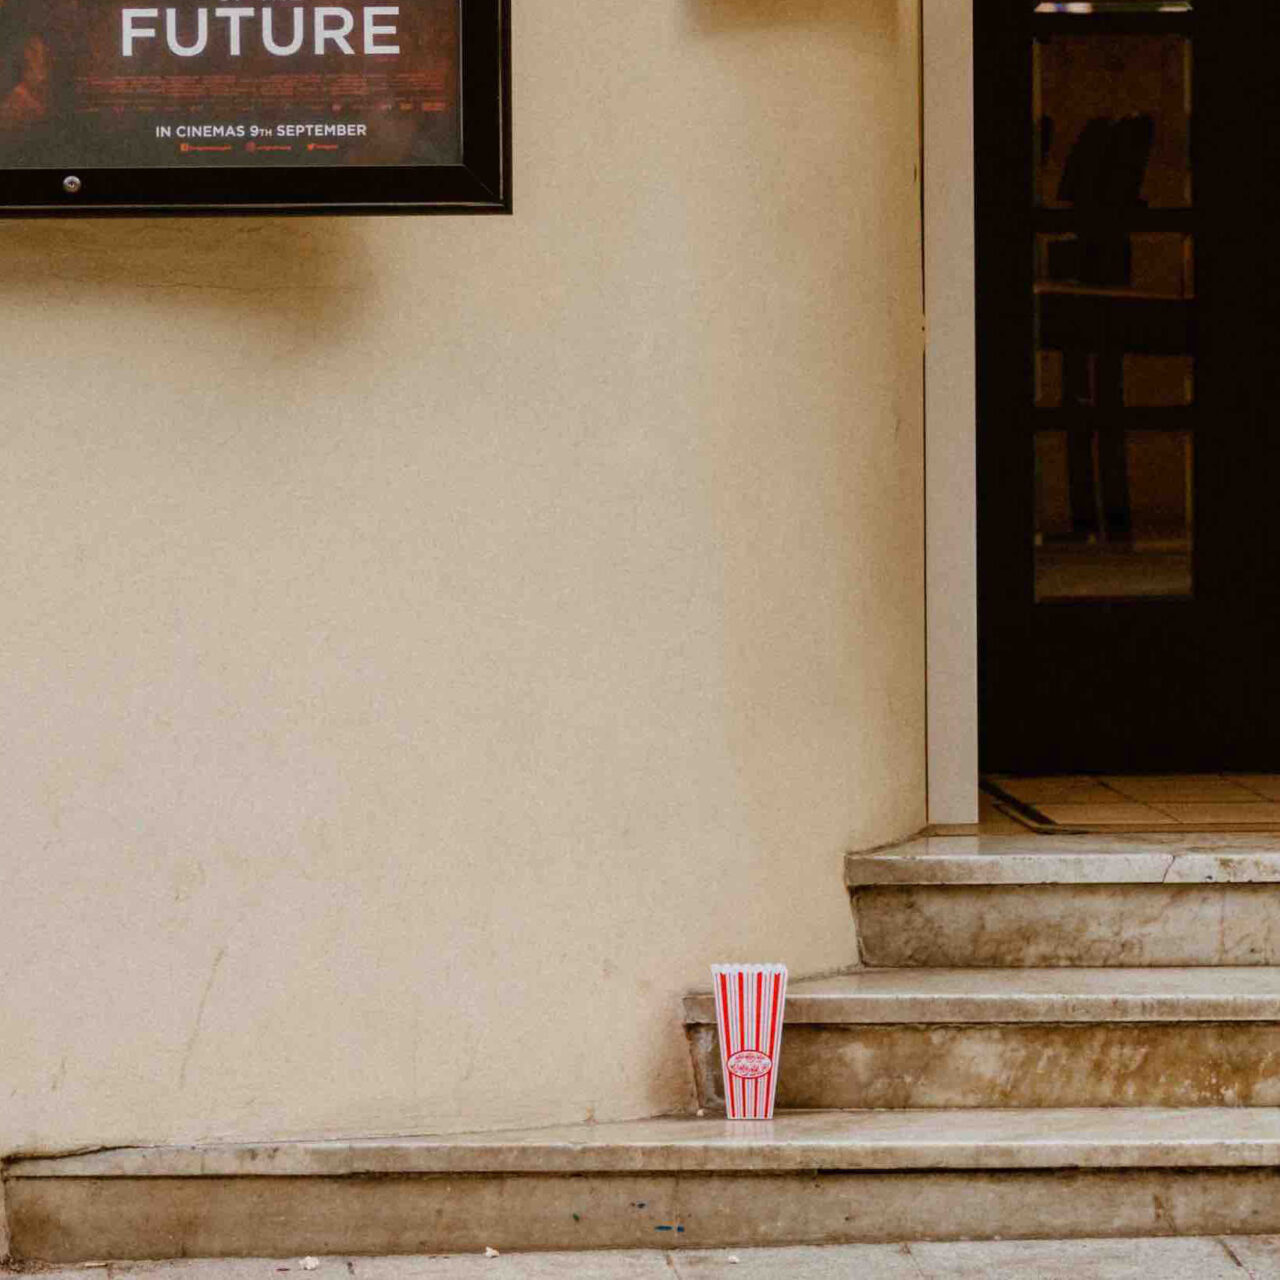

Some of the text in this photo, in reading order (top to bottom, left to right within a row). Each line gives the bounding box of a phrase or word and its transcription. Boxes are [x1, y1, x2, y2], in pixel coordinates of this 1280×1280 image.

[122, 6, 400, 57] FUTURE
[156, 126, 171, 137] IN
[176, 125, 245, 137] CINEMAS
[277, 124, 367, 137] SEPTEMBER
